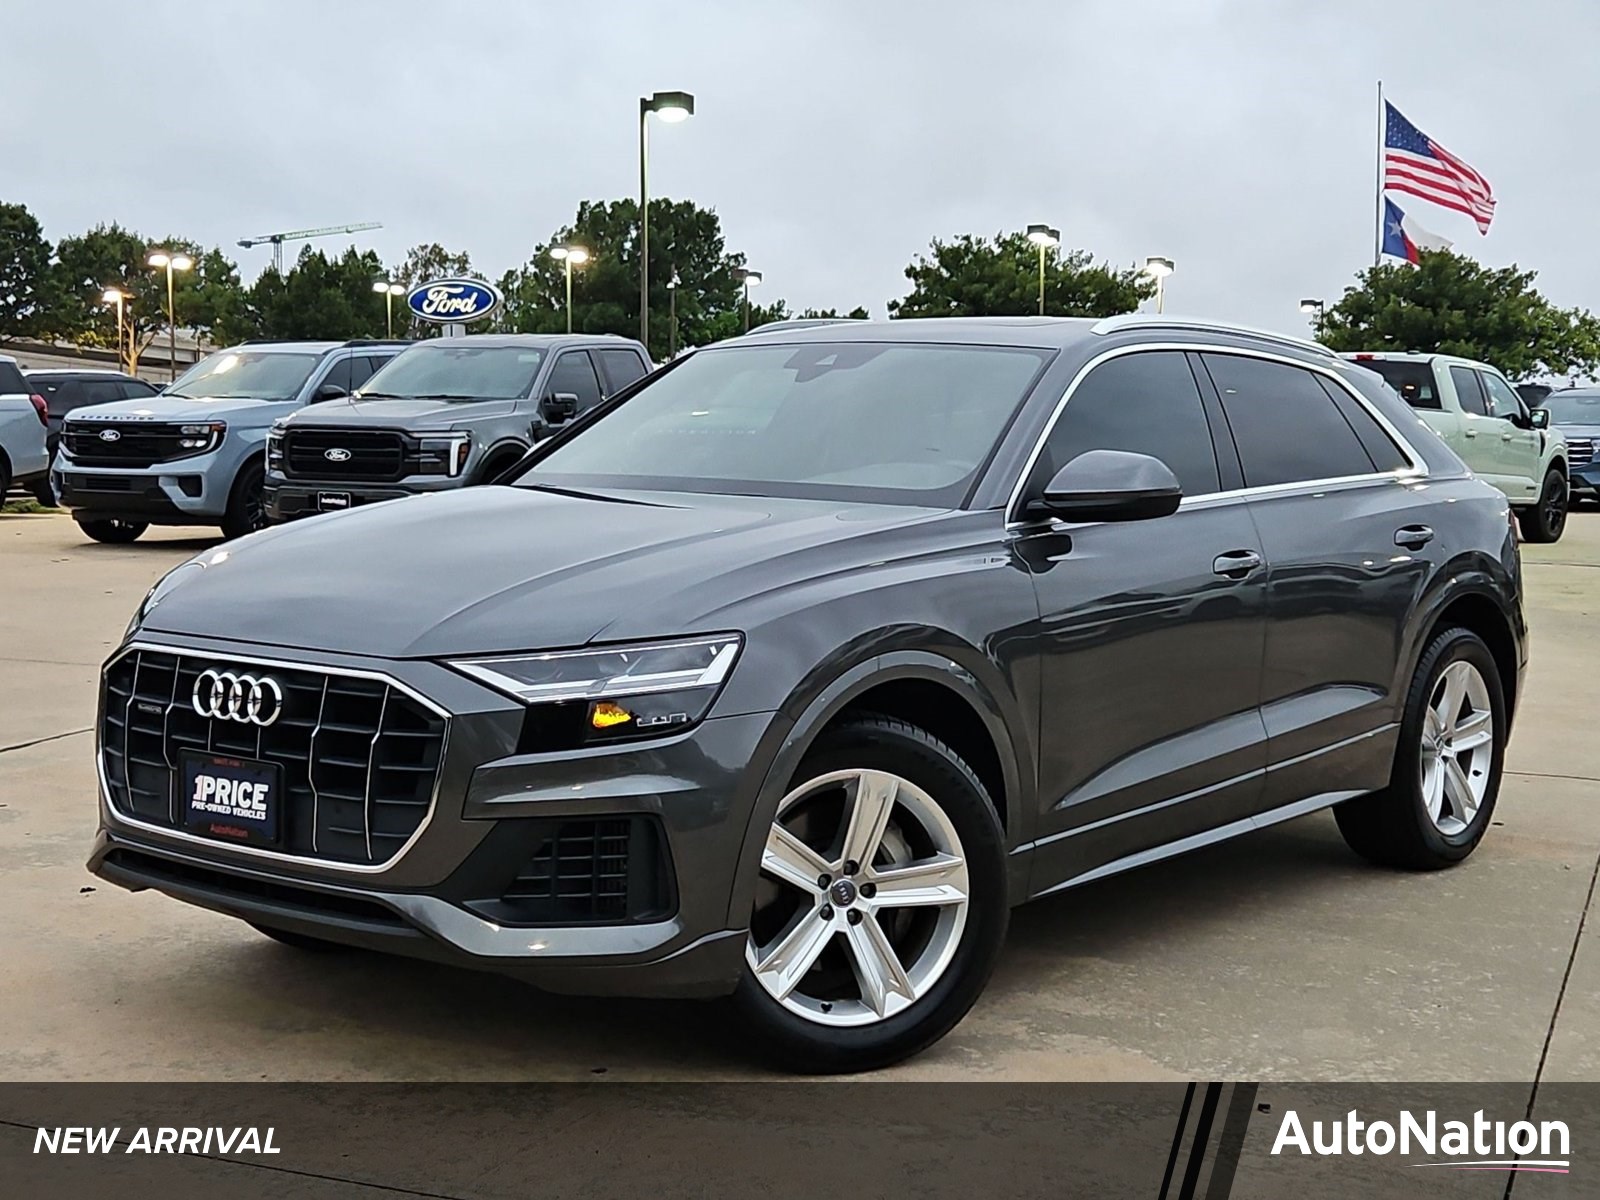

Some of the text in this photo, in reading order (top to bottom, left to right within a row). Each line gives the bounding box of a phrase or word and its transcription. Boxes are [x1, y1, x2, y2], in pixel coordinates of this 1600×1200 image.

[422, 287, 478, 314] Ford
[191, 800, 267, 821] PRE-OWNED VEHICLES
